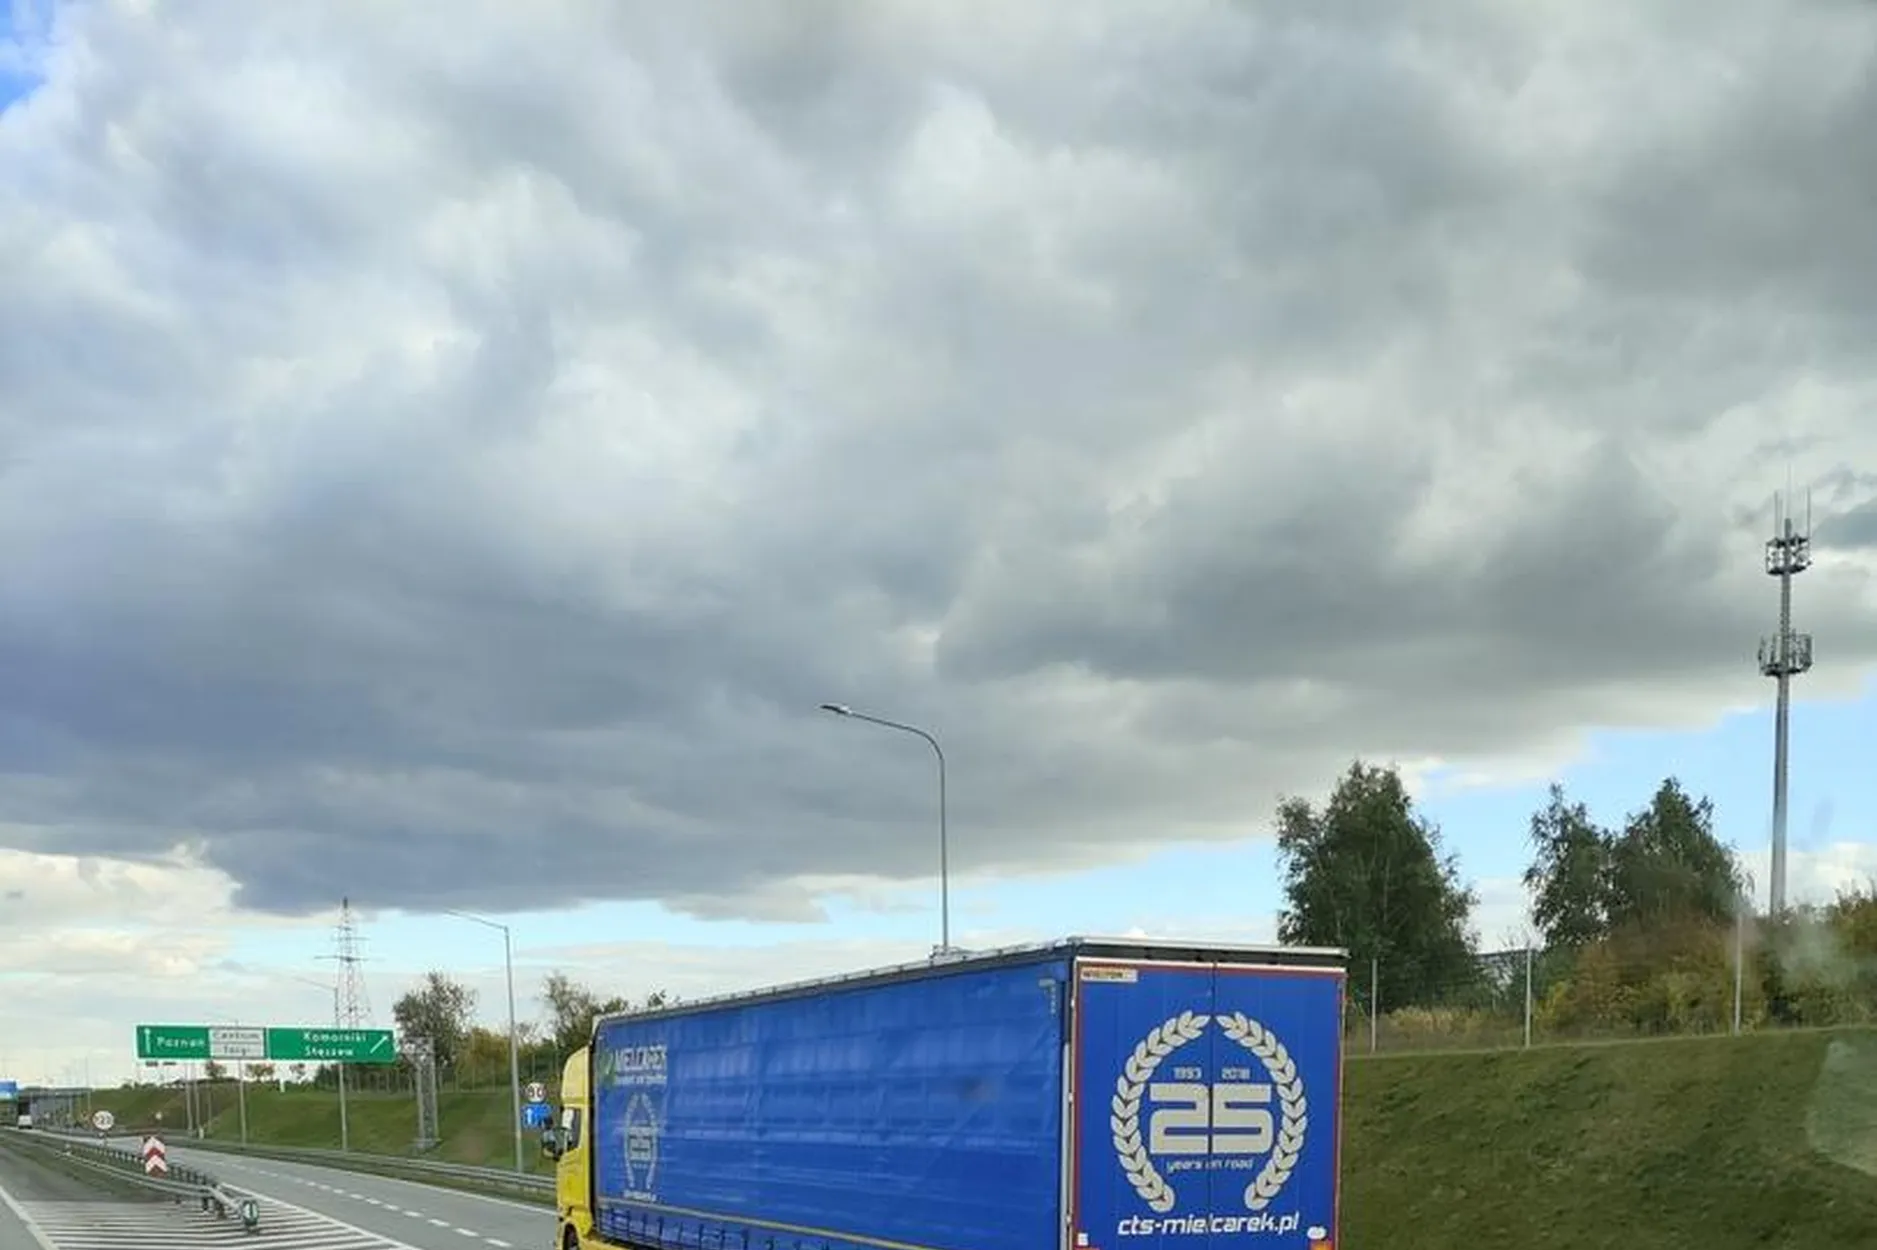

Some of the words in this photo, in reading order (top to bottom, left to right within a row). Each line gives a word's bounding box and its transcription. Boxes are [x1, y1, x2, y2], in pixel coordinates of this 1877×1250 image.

[303, 1030, 367, 1042] Komorniki
[1150, 1083, 1274, 1154] 25
[1166, 1159, 1202, 1174] years
[1224, 1158, 1255, 1170] road
[1117, 1211, 1300, 1236] cts-mielcarek.pl
